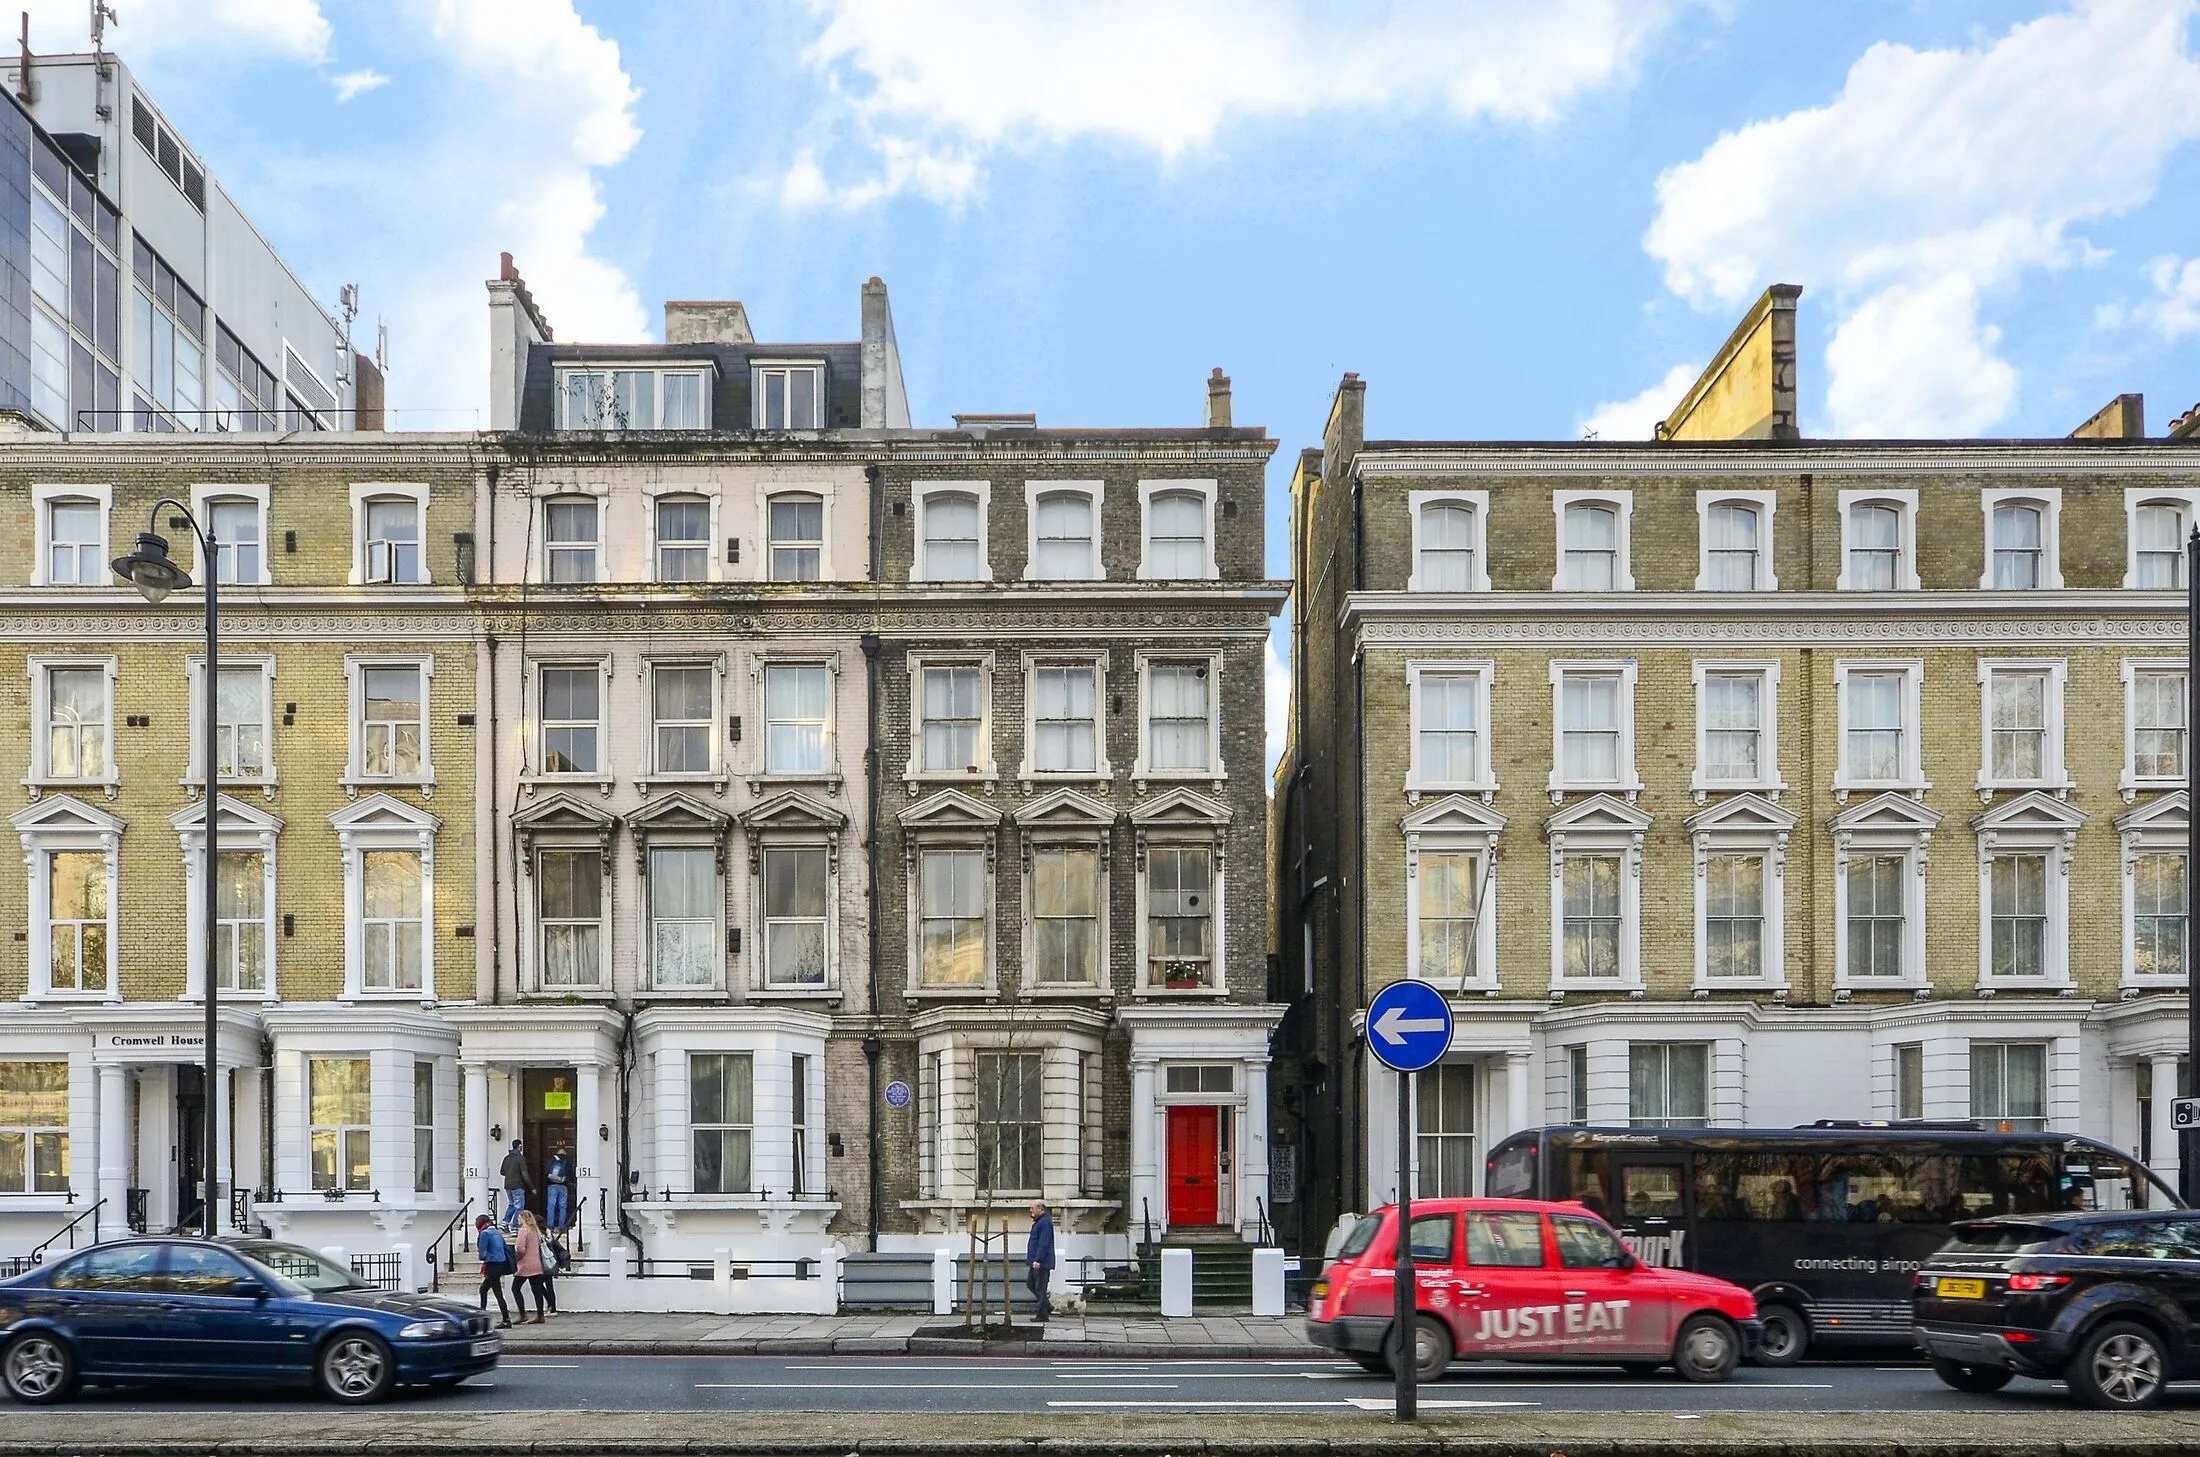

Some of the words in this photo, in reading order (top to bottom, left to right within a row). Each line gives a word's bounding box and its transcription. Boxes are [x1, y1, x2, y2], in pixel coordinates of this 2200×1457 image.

[111, 1036, 164, 1045] Cromwell
[171, 1036, 204, 1045] House
[466, 1167, 478, 1177] 151
[579, 1167, 591, 1177] 151
[1794, 1255, 1877, 1274] connecting
[1881, 1256, 1921, 1274] airpo
[1473, 1306, 1560, 1340] JUST
[1564, 1299, 1631, 1333] EAT
